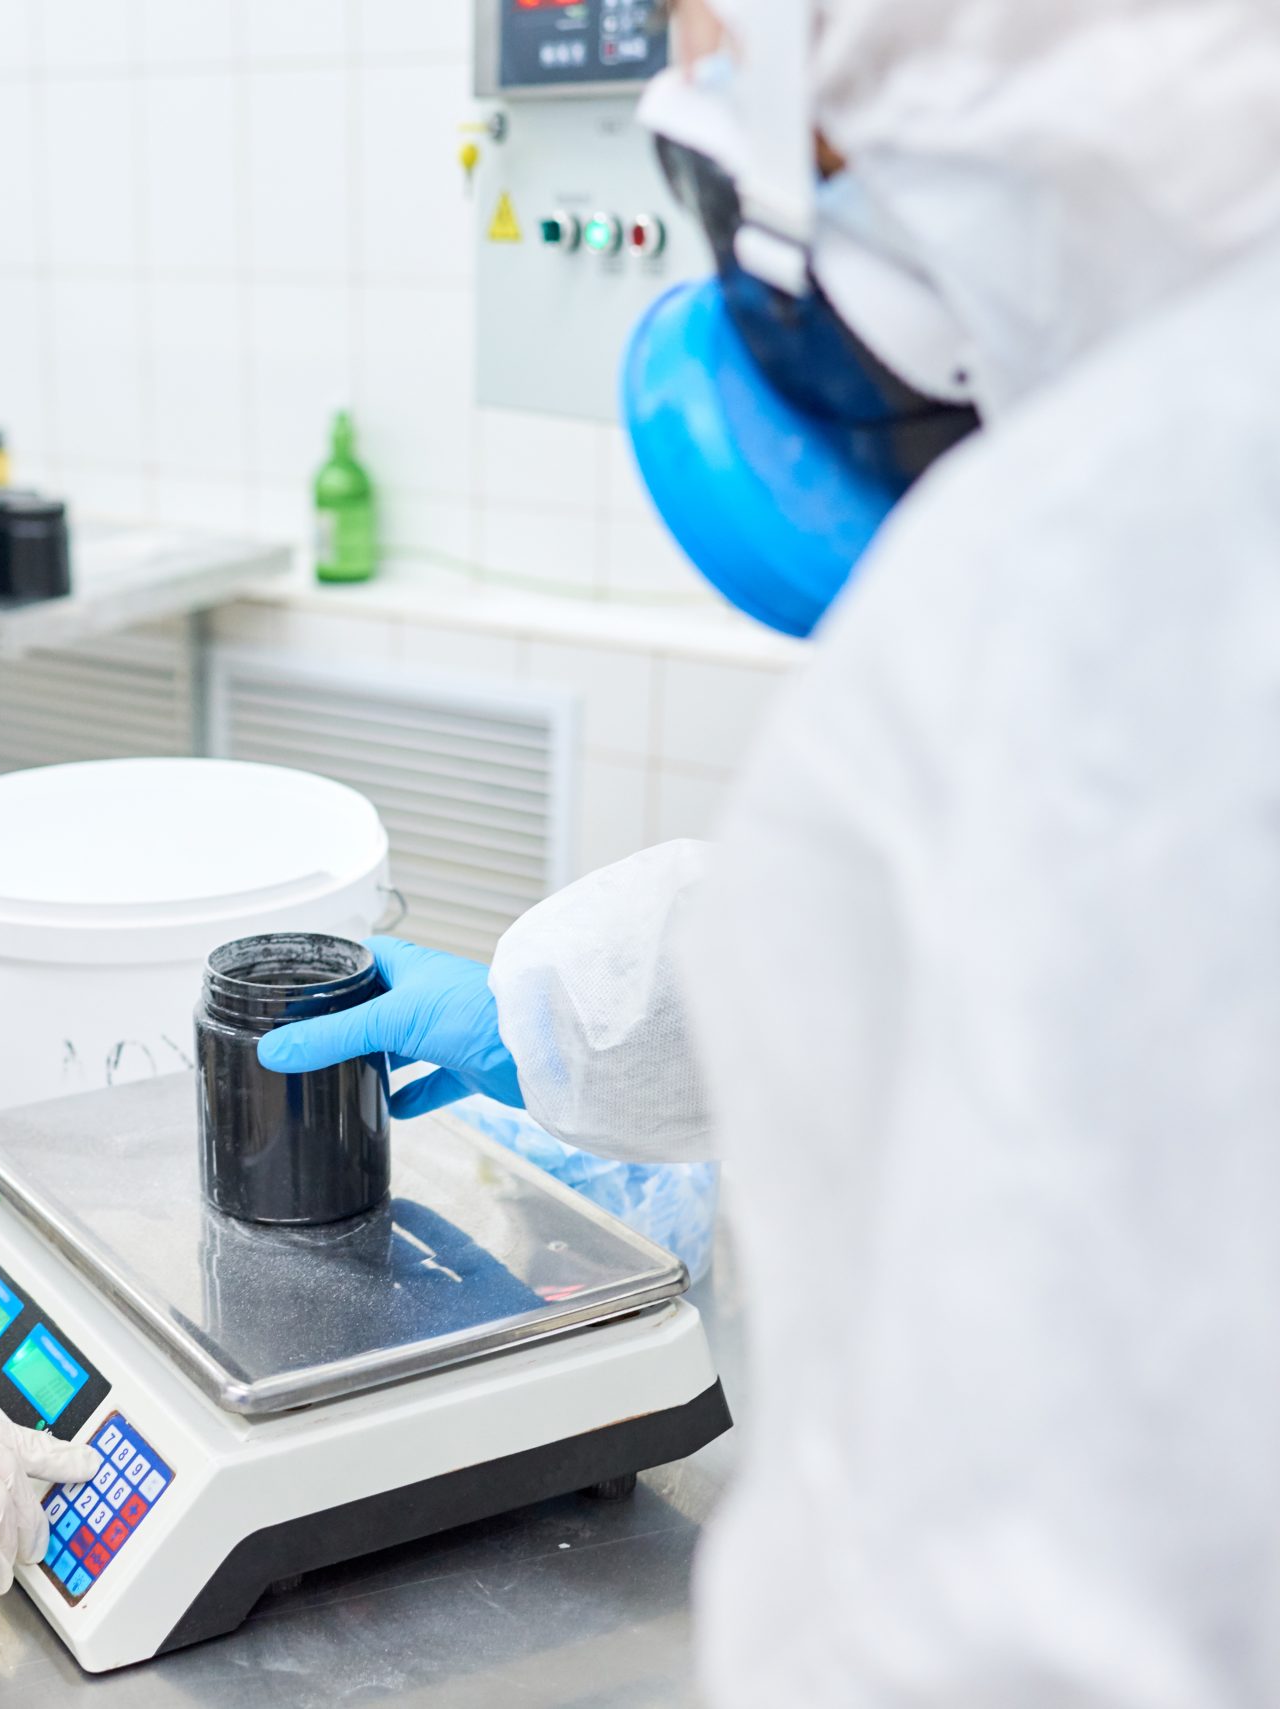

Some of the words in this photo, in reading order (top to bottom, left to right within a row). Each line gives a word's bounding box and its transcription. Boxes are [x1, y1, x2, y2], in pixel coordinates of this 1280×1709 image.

[104, 1432, 116, 1445] 7
[118, 1448, 129, 1461] 8
[132, 1463, 143, 1476] 9
[99, 1471, 111, 1485] 5
[113, 1487, 124, 1500] 6
[50, 1503, 61, 1516] 0
[80, 1495, 92, 1509] 2
[94, 1511, 106, 1524] 3
